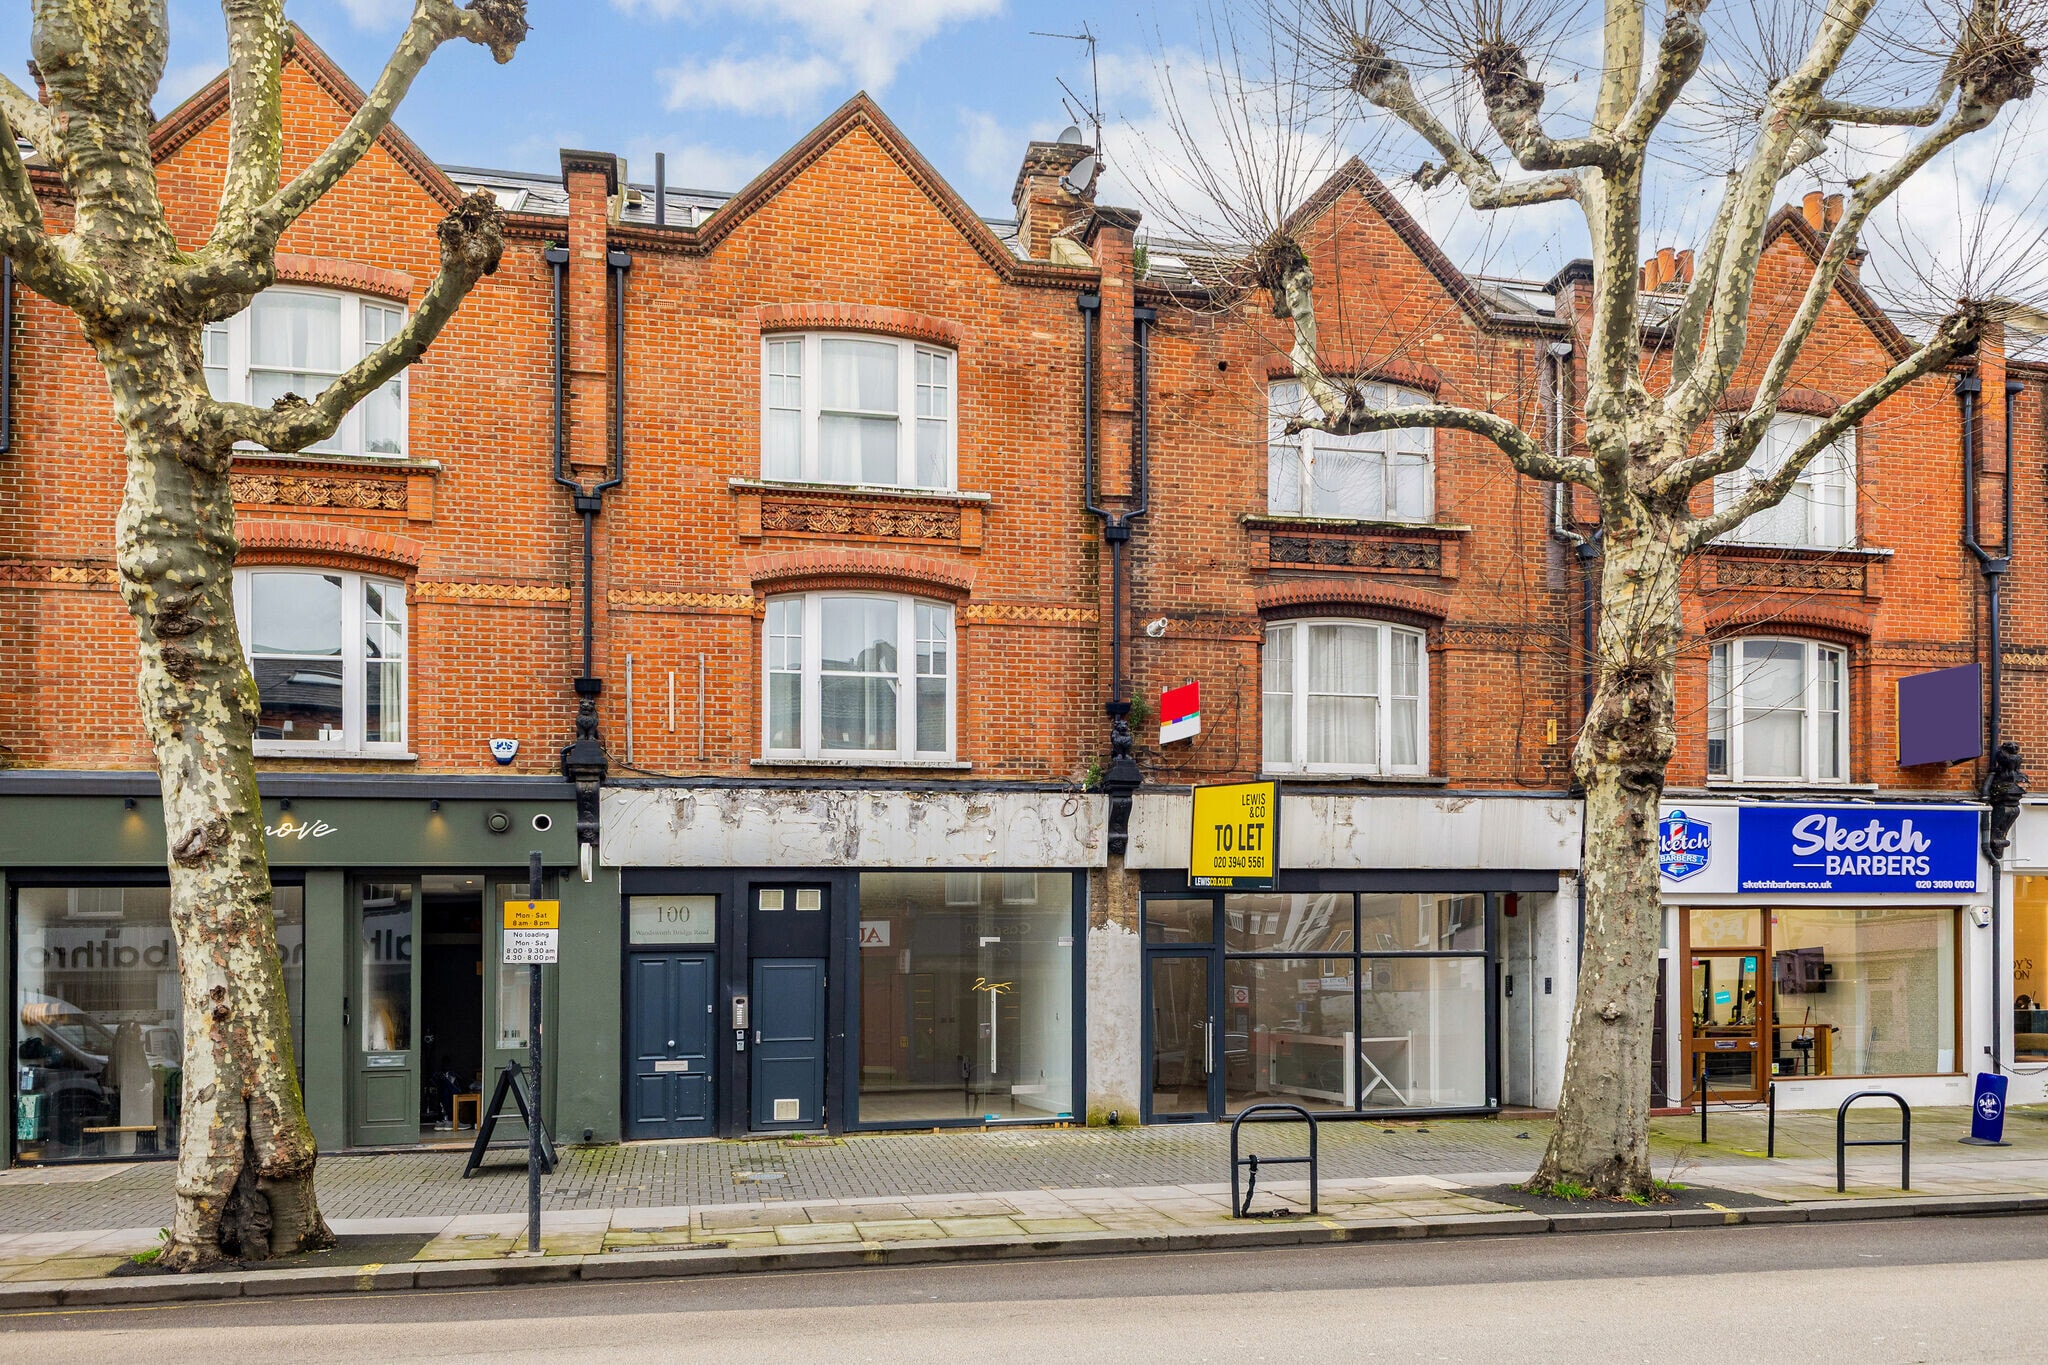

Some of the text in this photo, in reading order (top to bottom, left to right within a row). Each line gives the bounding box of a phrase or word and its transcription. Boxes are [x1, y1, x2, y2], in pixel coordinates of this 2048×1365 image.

[1241, 793, 1266, 806] LEWIS
[1249, 806, 1266, 818] &CO
[1214, 823, 1265, 852] TO LET
[1792, 814, 1931, 856] Sketch
[1213, 856, 1265, 868] 020 3940 5561
[1825, 855, 1931, 876] BARBERS
[1742, 880, 1833, 889] sketchbarbers.co.uk
[1915, 880, 1932, 889] 020
[657, 905, 690, 923] 100
[1707, 917, 1745, 941] 94
